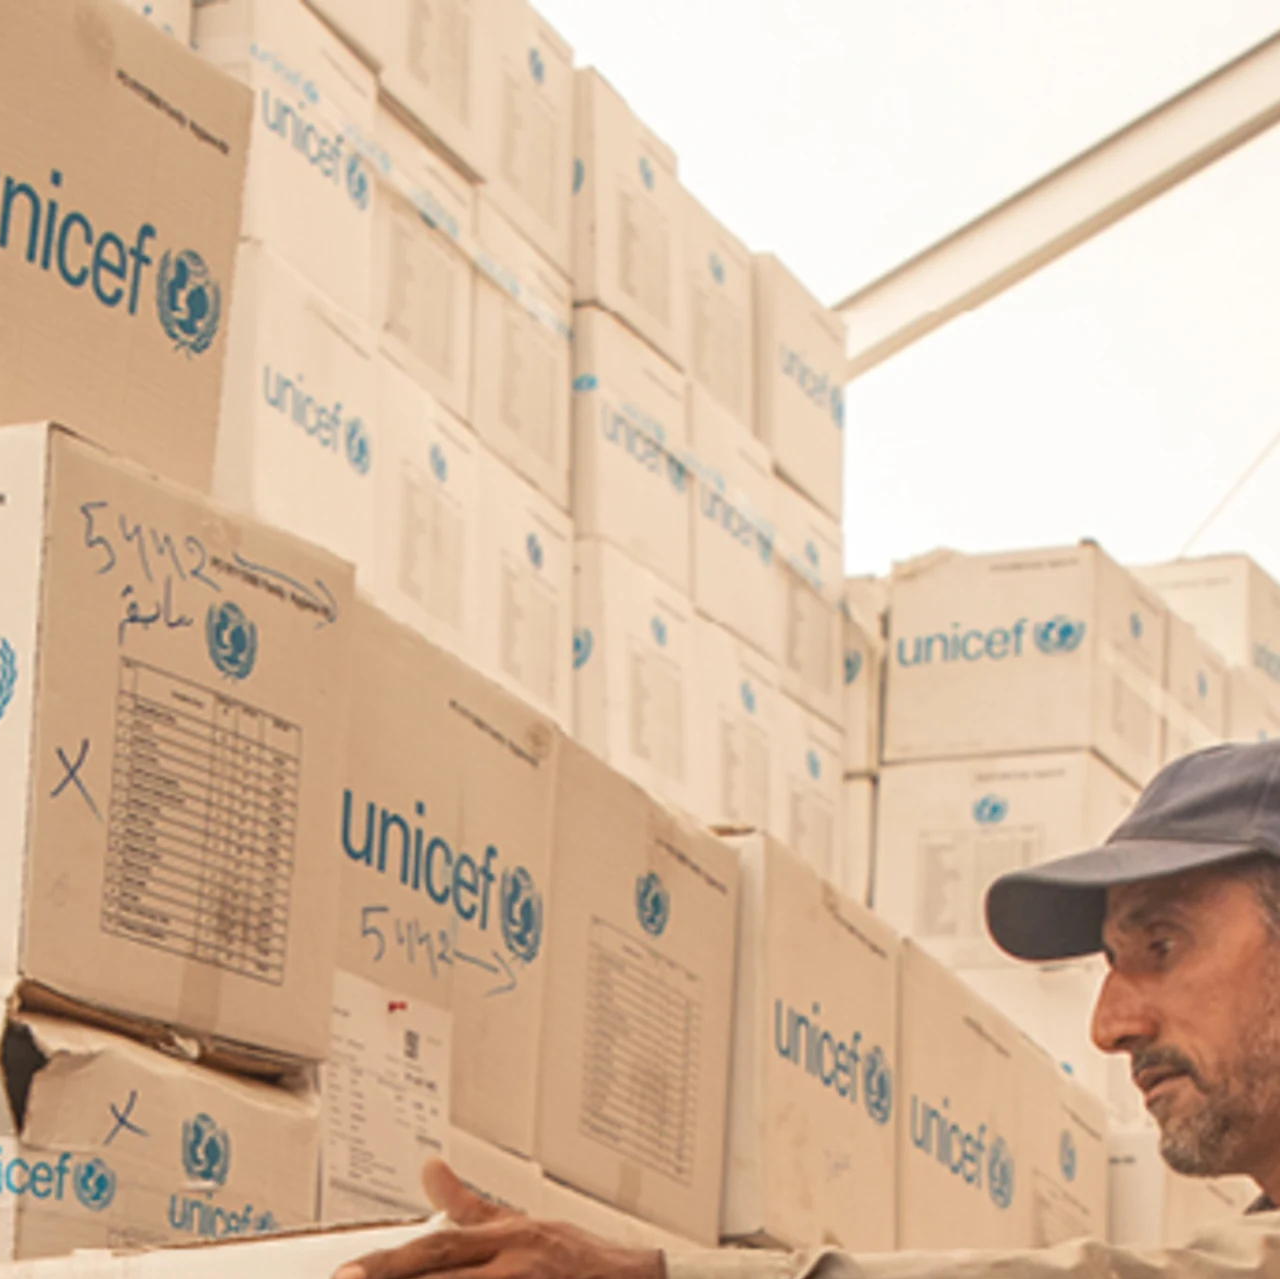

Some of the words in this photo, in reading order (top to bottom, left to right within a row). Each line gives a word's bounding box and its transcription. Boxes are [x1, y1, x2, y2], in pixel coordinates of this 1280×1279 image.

[263, 363, 343, 454] unicef
[897, 616, 1029, 669] unicef
[340, 787, 499, 932] unicef
[774, 998, 862, 1104] unicef
[910, 1095, 986, 1191] unicef
